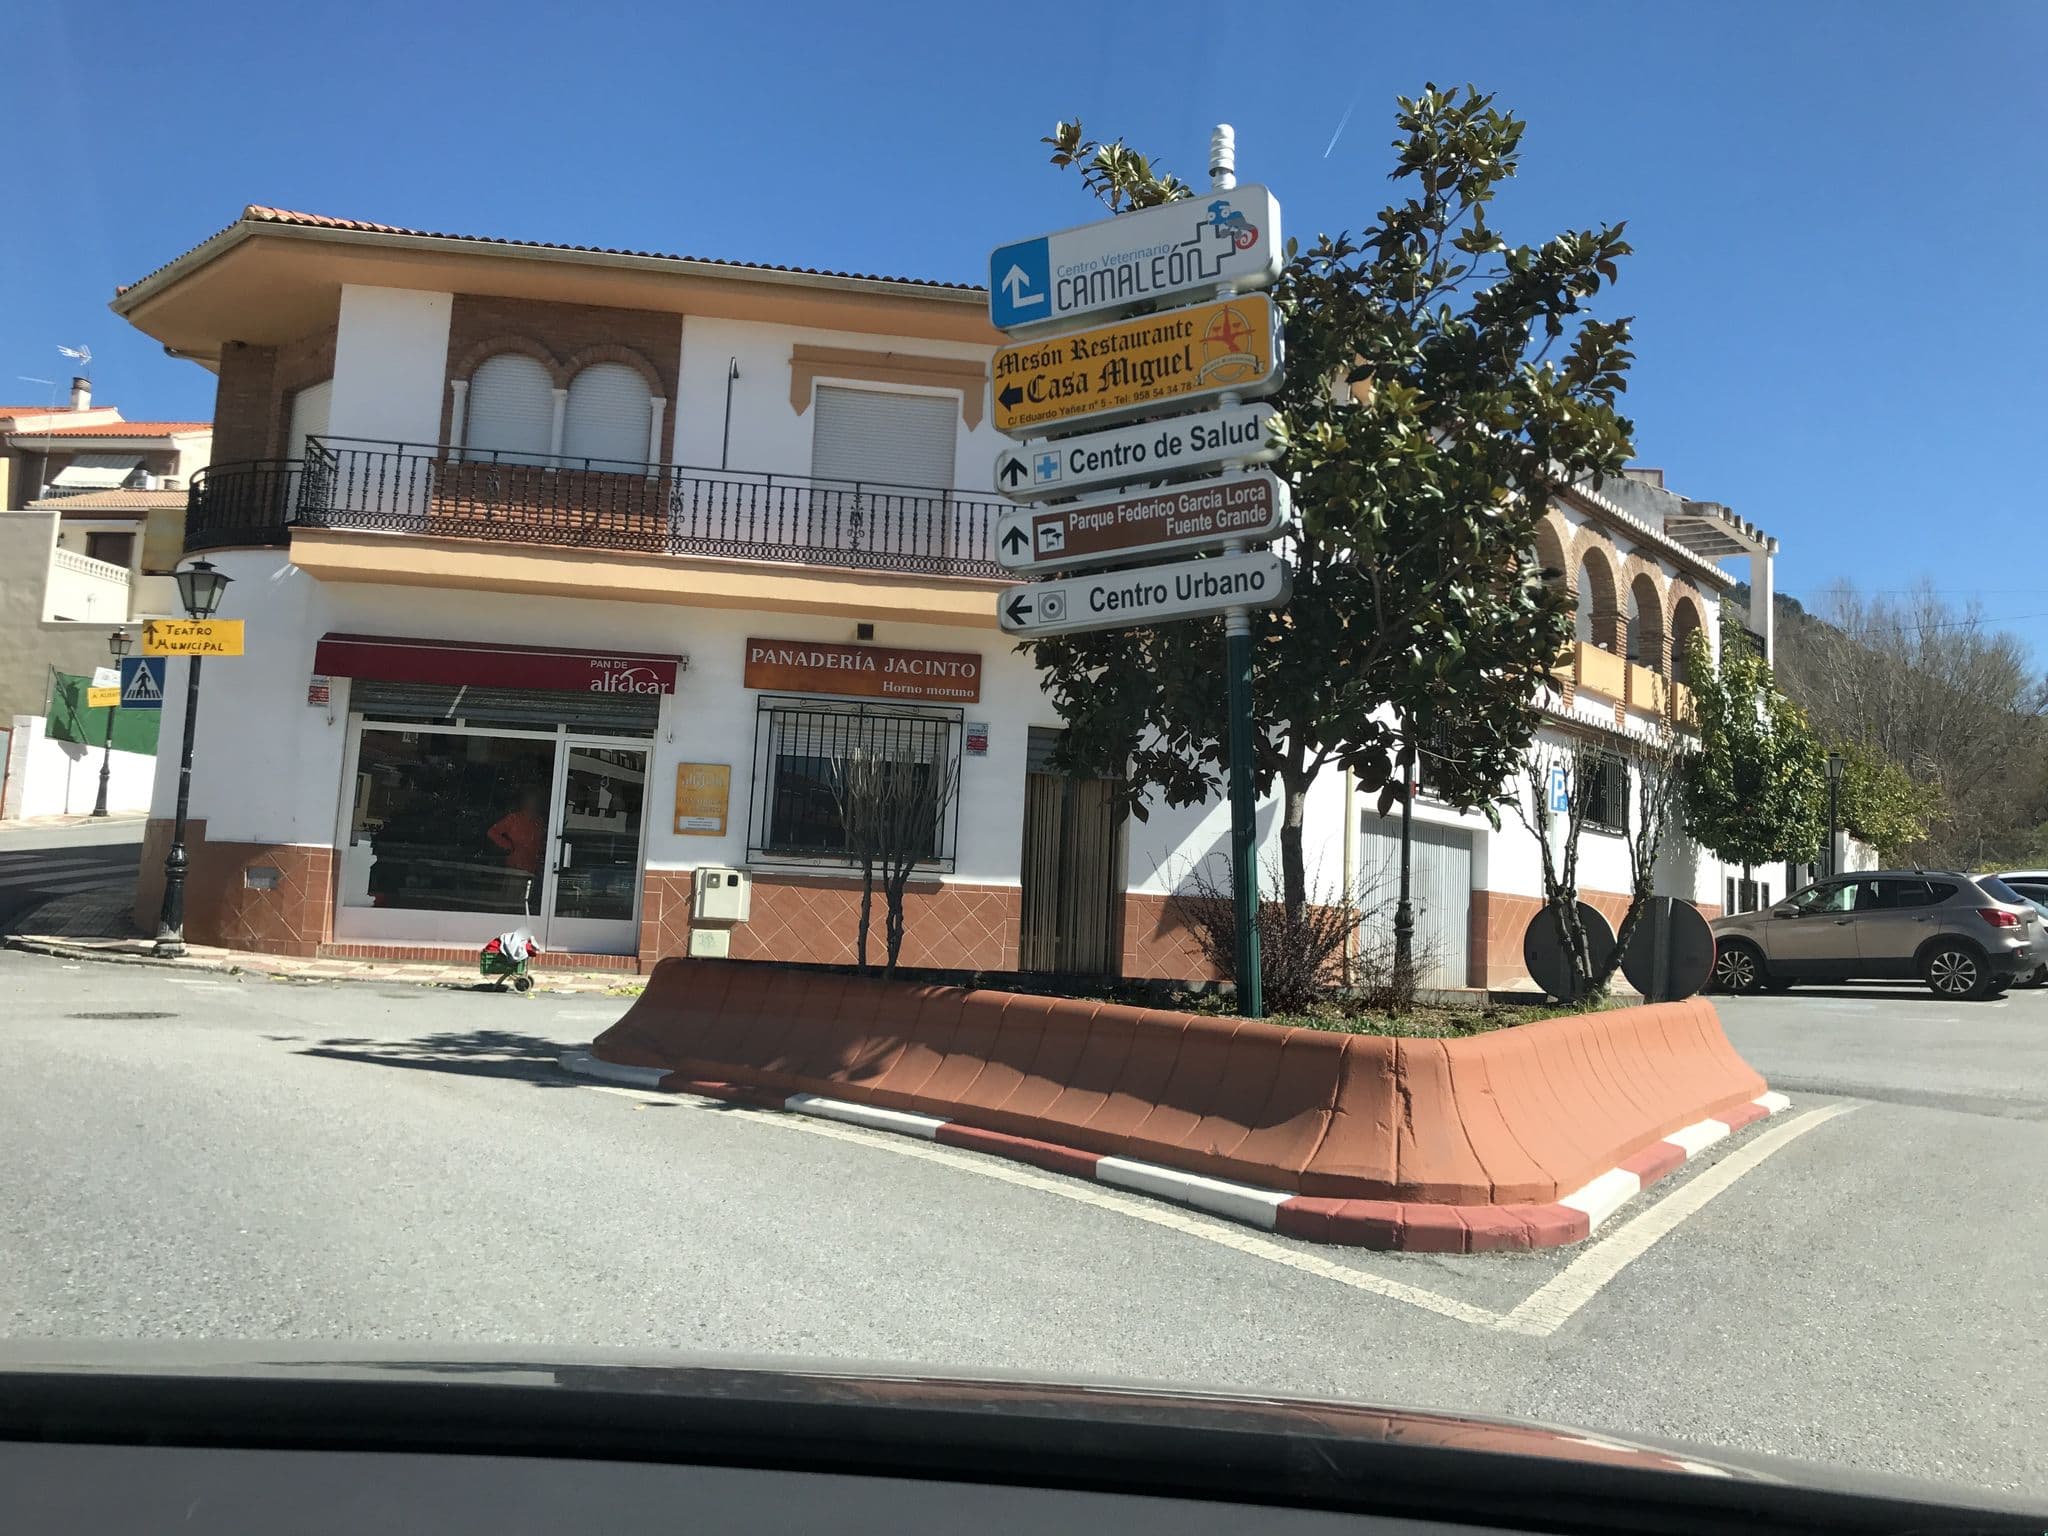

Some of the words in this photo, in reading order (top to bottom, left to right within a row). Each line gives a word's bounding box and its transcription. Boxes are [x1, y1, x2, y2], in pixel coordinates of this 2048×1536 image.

[1057, 260, 1098, 278] Centro
[1101, 242, 1170, 267] Veterinario
[1057, 244, 1203, 311] CAMALEÓN
[996, 344, 1063, 379] Mesón
[1070, 319, 1193, 360] Restaurante
[1027, 371, 1089, 403] Casa
[1097, 343, 1193, 393] Miguel
[1007, 416, 1017, 426] C/
[1019, 410, 1057, 424] Eduardo
[1133, 390, 1150, 401] 958
[1152, 387, 1164, 397] 54
[1167, 384, 1178, 394] 34
[1070, 440, 1146, 474] Centro
[1154, 432, 1182, 458] de
[1190, 414, 1260, 452] Salud
[1069, 511, 1114, 532] Parque
[1117, 499, 1175, 524] Federico
[1178, 489, 1222, 514] García
[1226, 485, 1266, 506] Lorca
[1166, 513, 1212, 537] Fuente
[1216, 504, 1267, 529] Grande
[1089, 581, 1168, 612] Centro
[1175, 570, 1265, 601] Urbano
[155, 639, 224, 652] MUNICIPAL
[166, 624, 213, 636] TEATRO
[590, 660, 611, 669] PAN
[614, 661, 628, 669] DE
[751, 647, 876, 671] PANADERÍA
[884, 657, 976, 678] JACINTO
[590, 669, 670, 694] alfacar
[883, 681, 922, 694] Horno
[926, 686, 975, 698] moruno
